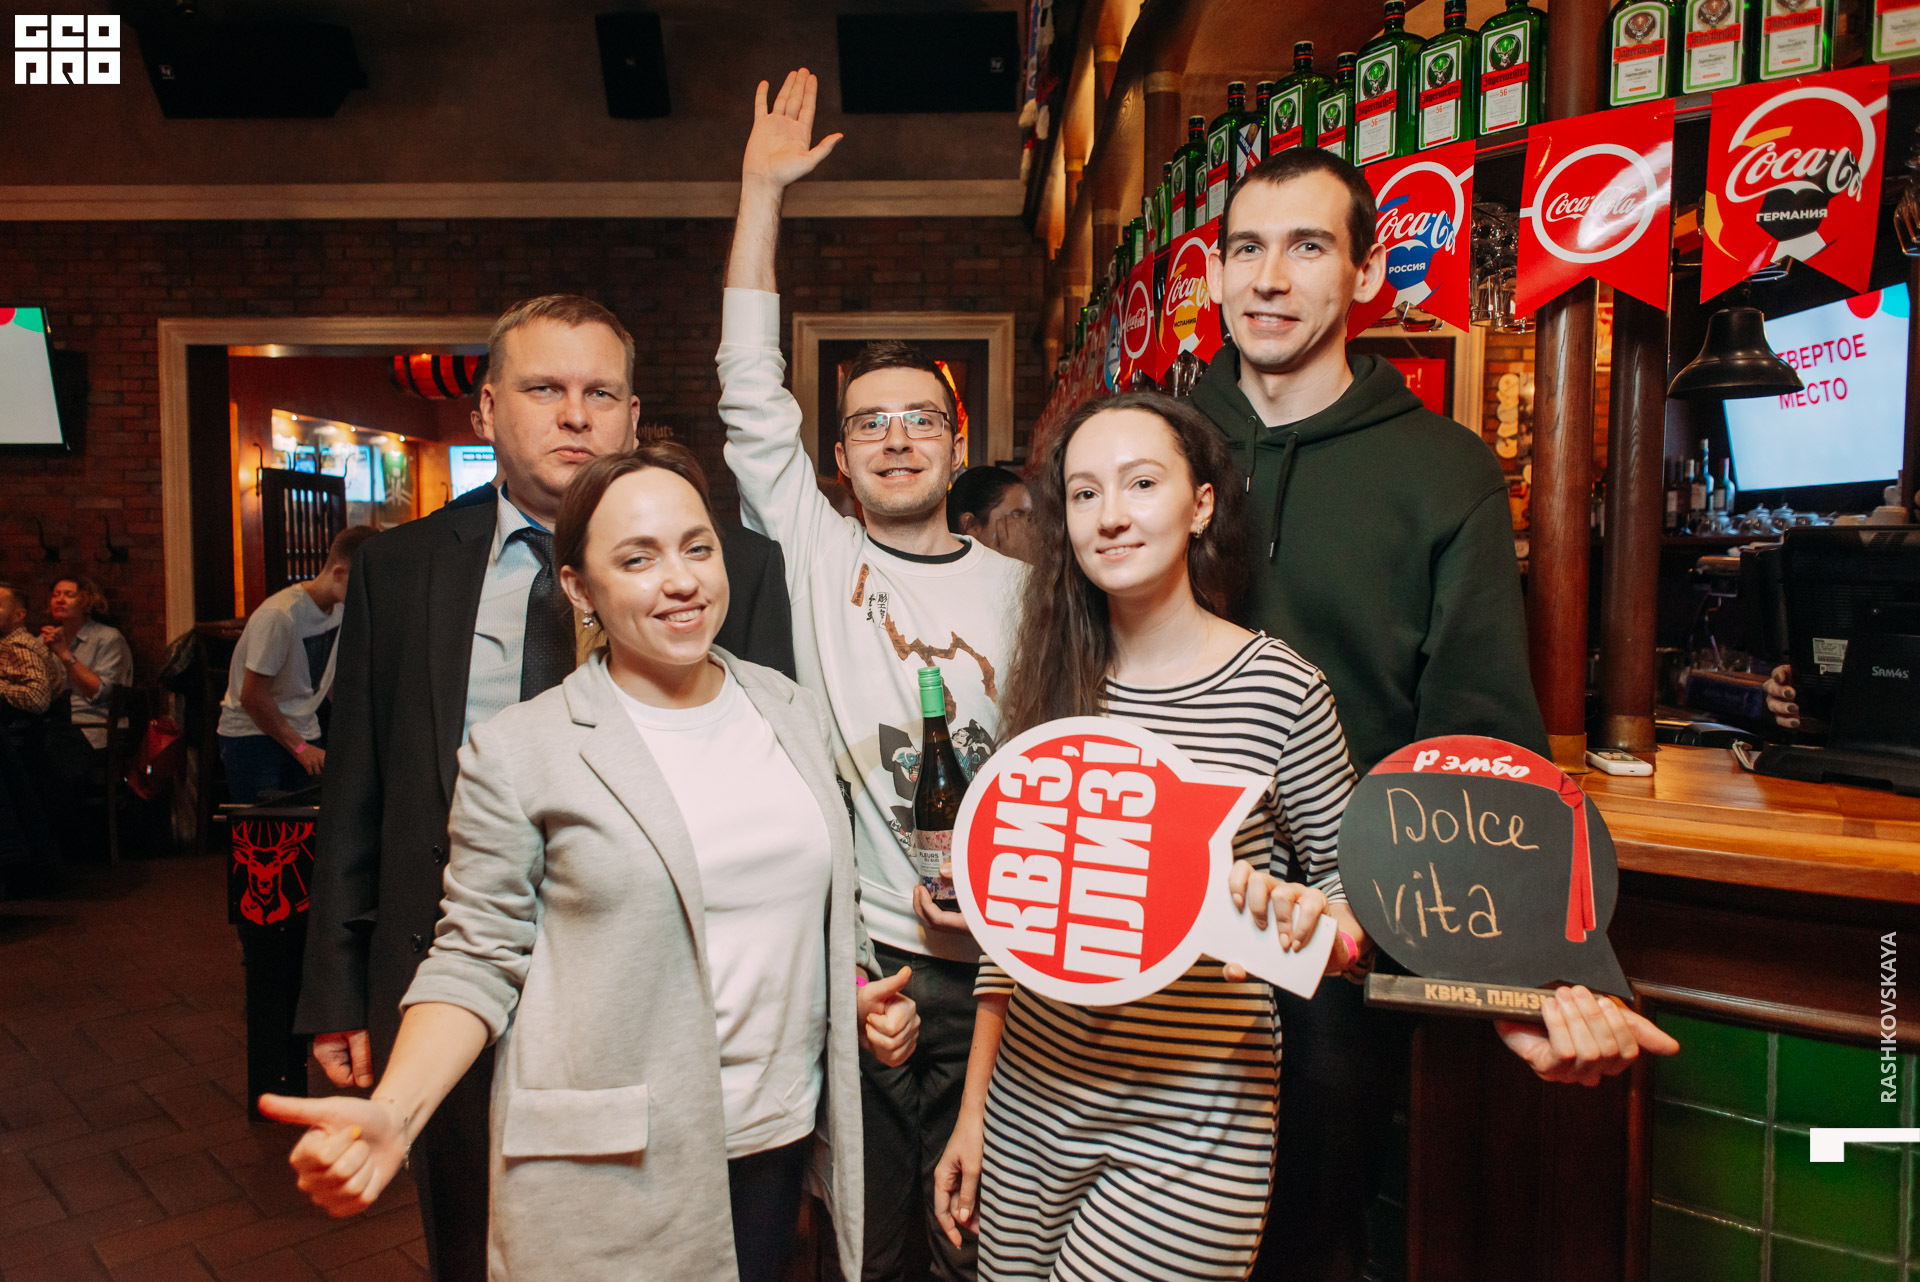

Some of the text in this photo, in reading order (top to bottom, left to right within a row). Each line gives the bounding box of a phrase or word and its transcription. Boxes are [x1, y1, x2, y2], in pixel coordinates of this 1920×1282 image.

[1546, 184, 1642, 224] Coca-Cola
[1756, 208, 1829, 223] ГЕРМАНИЯ
[1388, 262, 1426, 275] РОССИЯ
[1776, 333, 1868, 374] ВЕРТОЕ
[1386, 787, 1540, 850] Dolce
[985, 744, 1080, 957] КВИЗ,
[1063, 740, 1158, 979] ПЛИЗ!
[1424, 983, 1483, 1008] КВИЗ,
